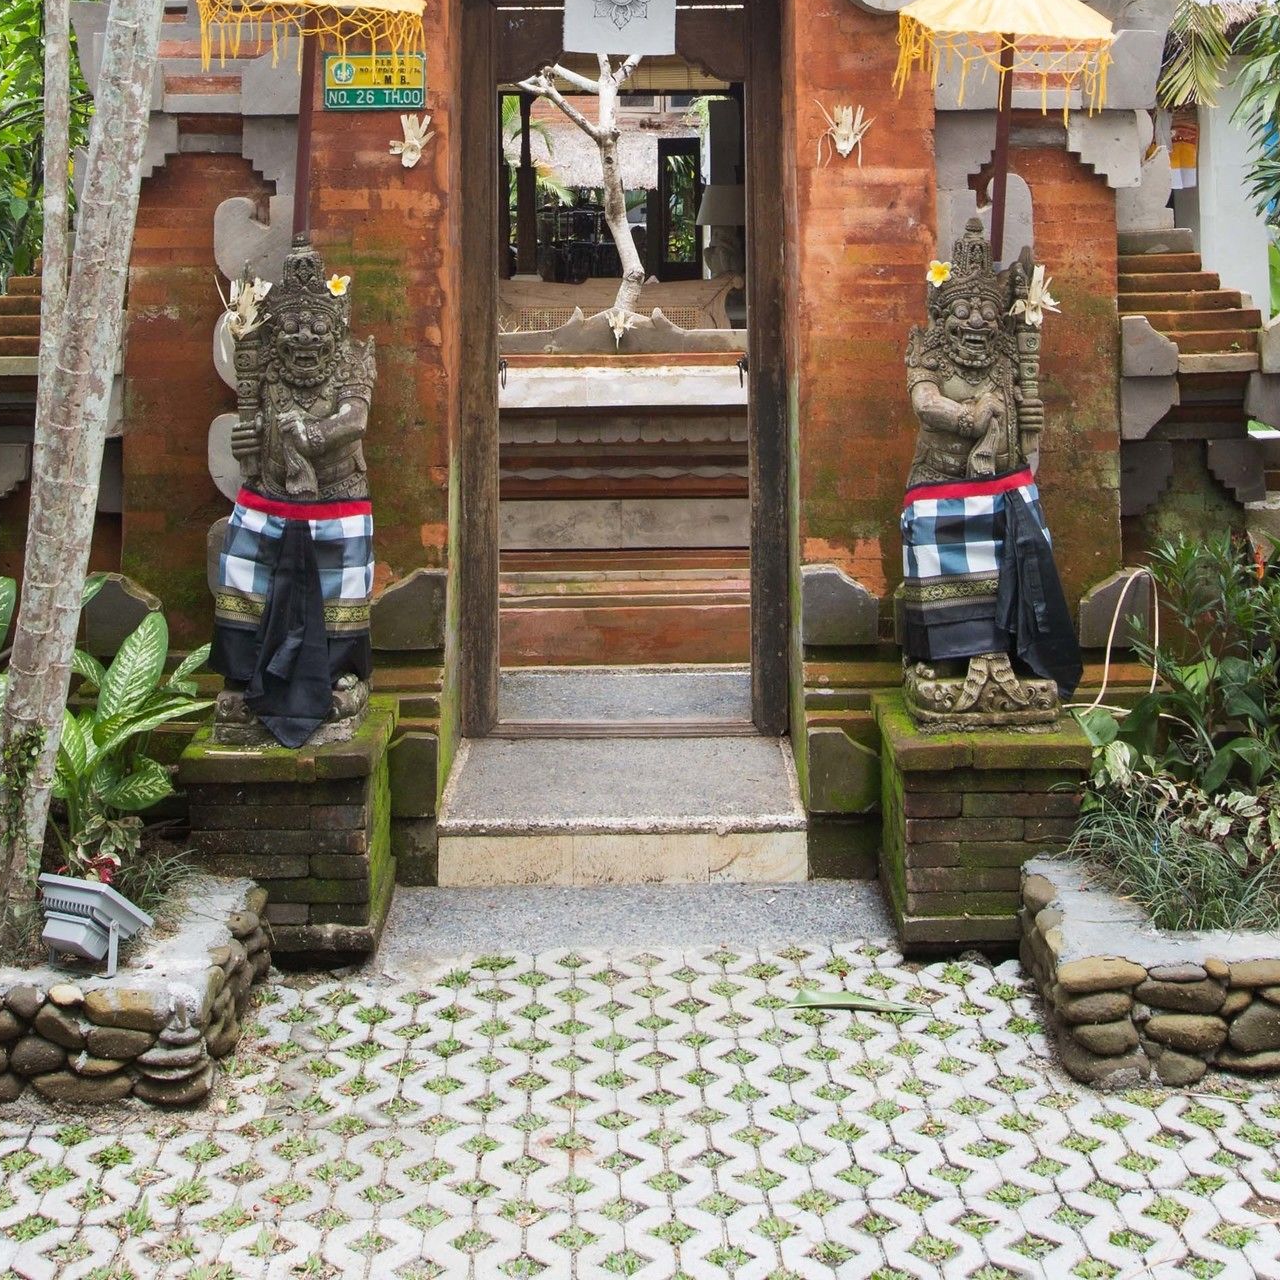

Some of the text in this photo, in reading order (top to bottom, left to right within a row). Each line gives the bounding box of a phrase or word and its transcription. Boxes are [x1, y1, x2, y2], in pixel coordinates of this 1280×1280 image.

[328, 90, 420, 104] NO. 26 TH.00
